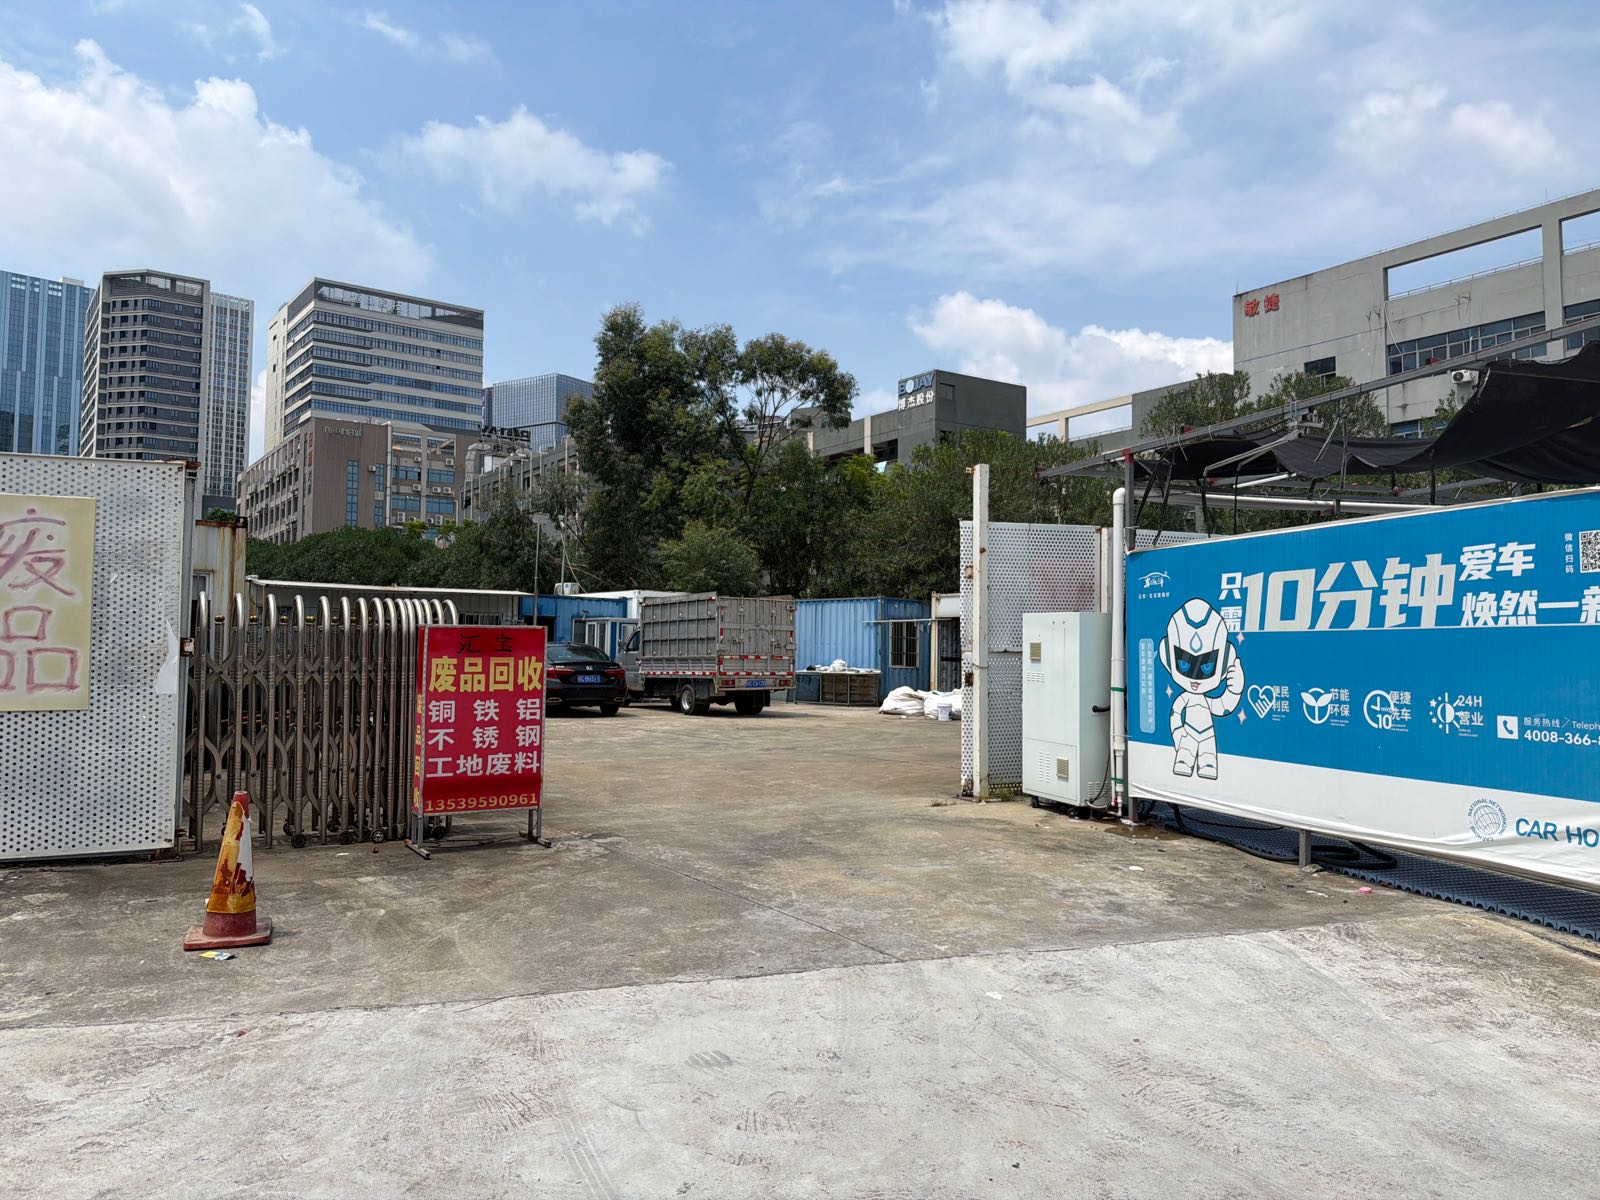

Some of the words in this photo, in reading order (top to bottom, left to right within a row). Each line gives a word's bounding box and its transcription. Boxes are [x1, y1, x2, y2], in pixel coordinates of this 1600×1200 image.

[1459, 541, 1536, 582] 爱车
[1218, 571, 1242, 632] 只需
[1242, 552, 1457, 632] 10分钟
[429, 655, 543, 693] 废品回收
[428, 698, 541, 724] 铜铁铝
[1458, 694, 1483, 708] 24H
[427, 724, 541, 752] 不锈钢
[1523, 729, 1600, 746] 4008-366-
[426, 750, 540, 778] 工地废料
[425, 793, 538, 812] 13539590961
[1515, 817, 1560, 842] CAR
